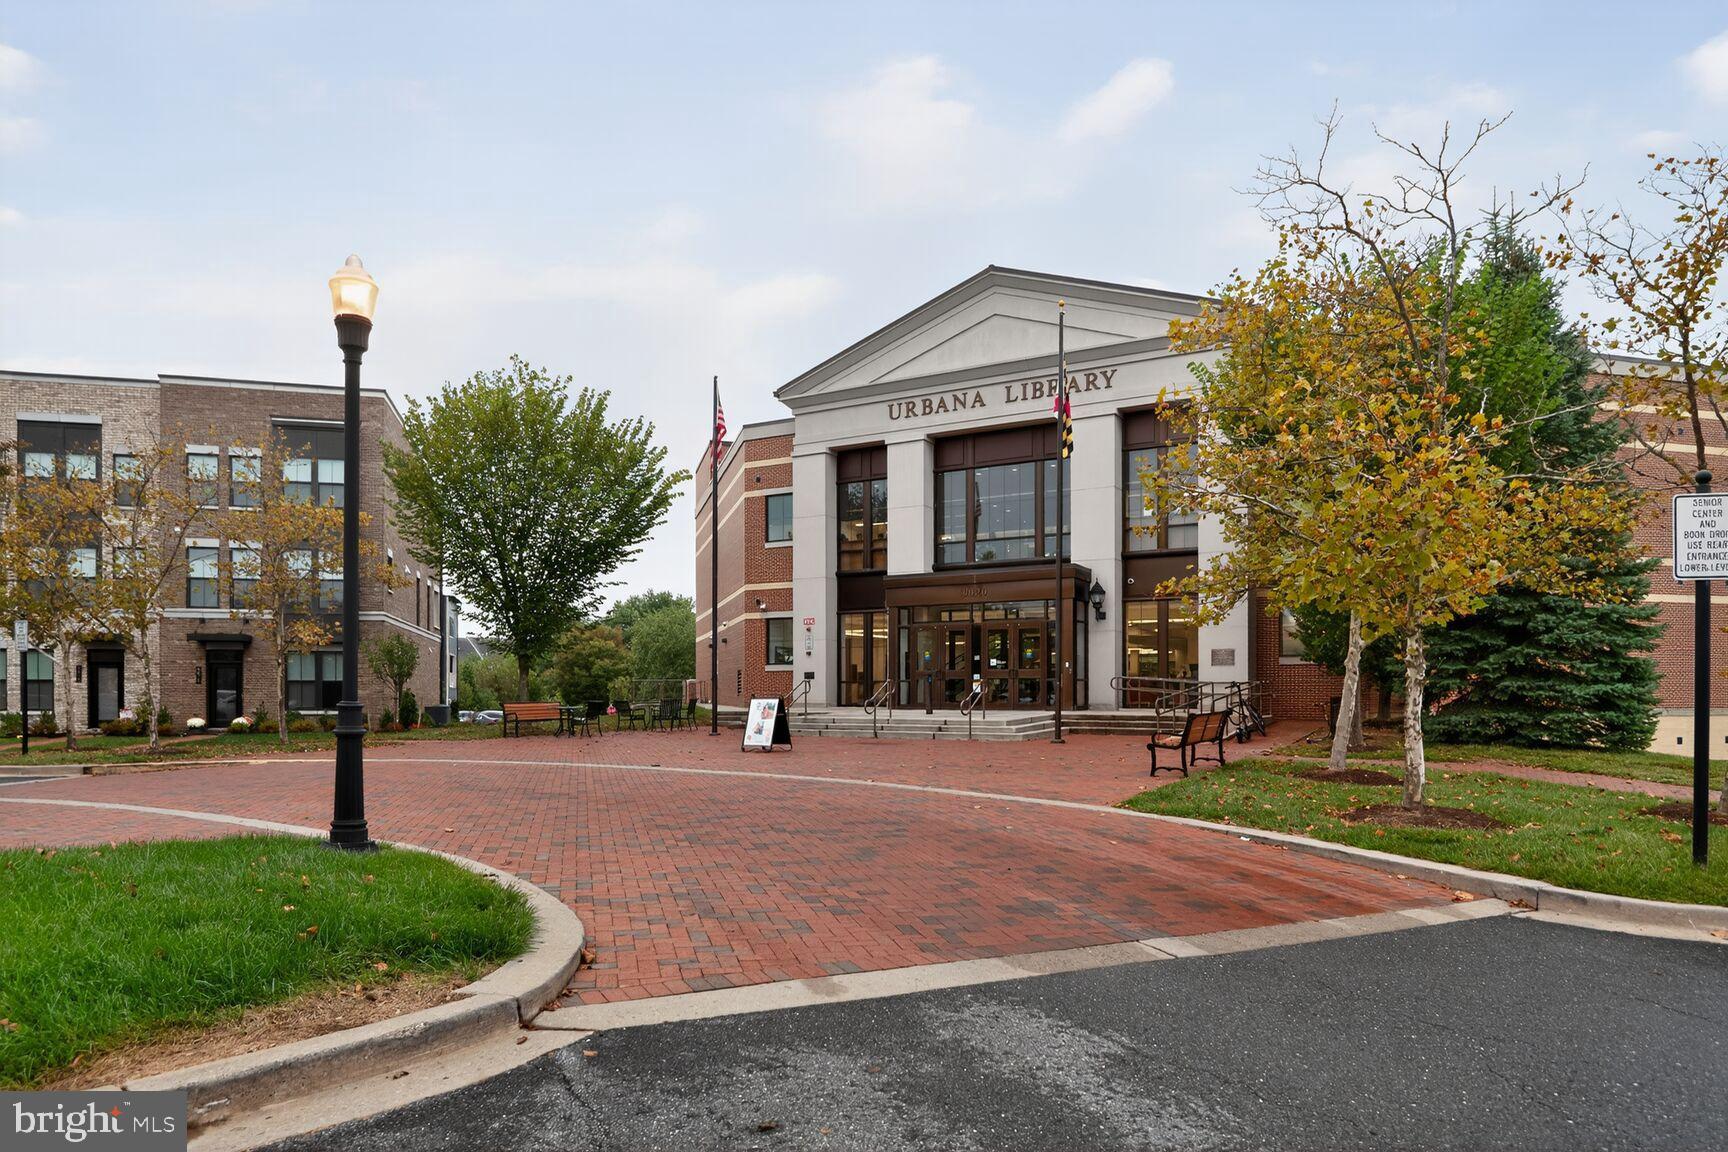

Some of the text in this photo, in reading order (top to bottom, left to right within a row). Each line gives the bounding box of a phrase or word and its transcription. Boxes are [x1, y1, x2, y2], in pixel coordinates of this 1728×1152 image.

[888, 369, 1117, 420] URBANA LIBRARY
[1692, 498, 1723, 507] SENIOR
[1692, 509, 1723, 518] CENTER
[1699, 520, 1717, 528] AND
[1684, 530, 1705, 539] BOOK
[1687, 540, 1728, 549] USE REAR
[1679, 564, 1707, 572] LOWER
